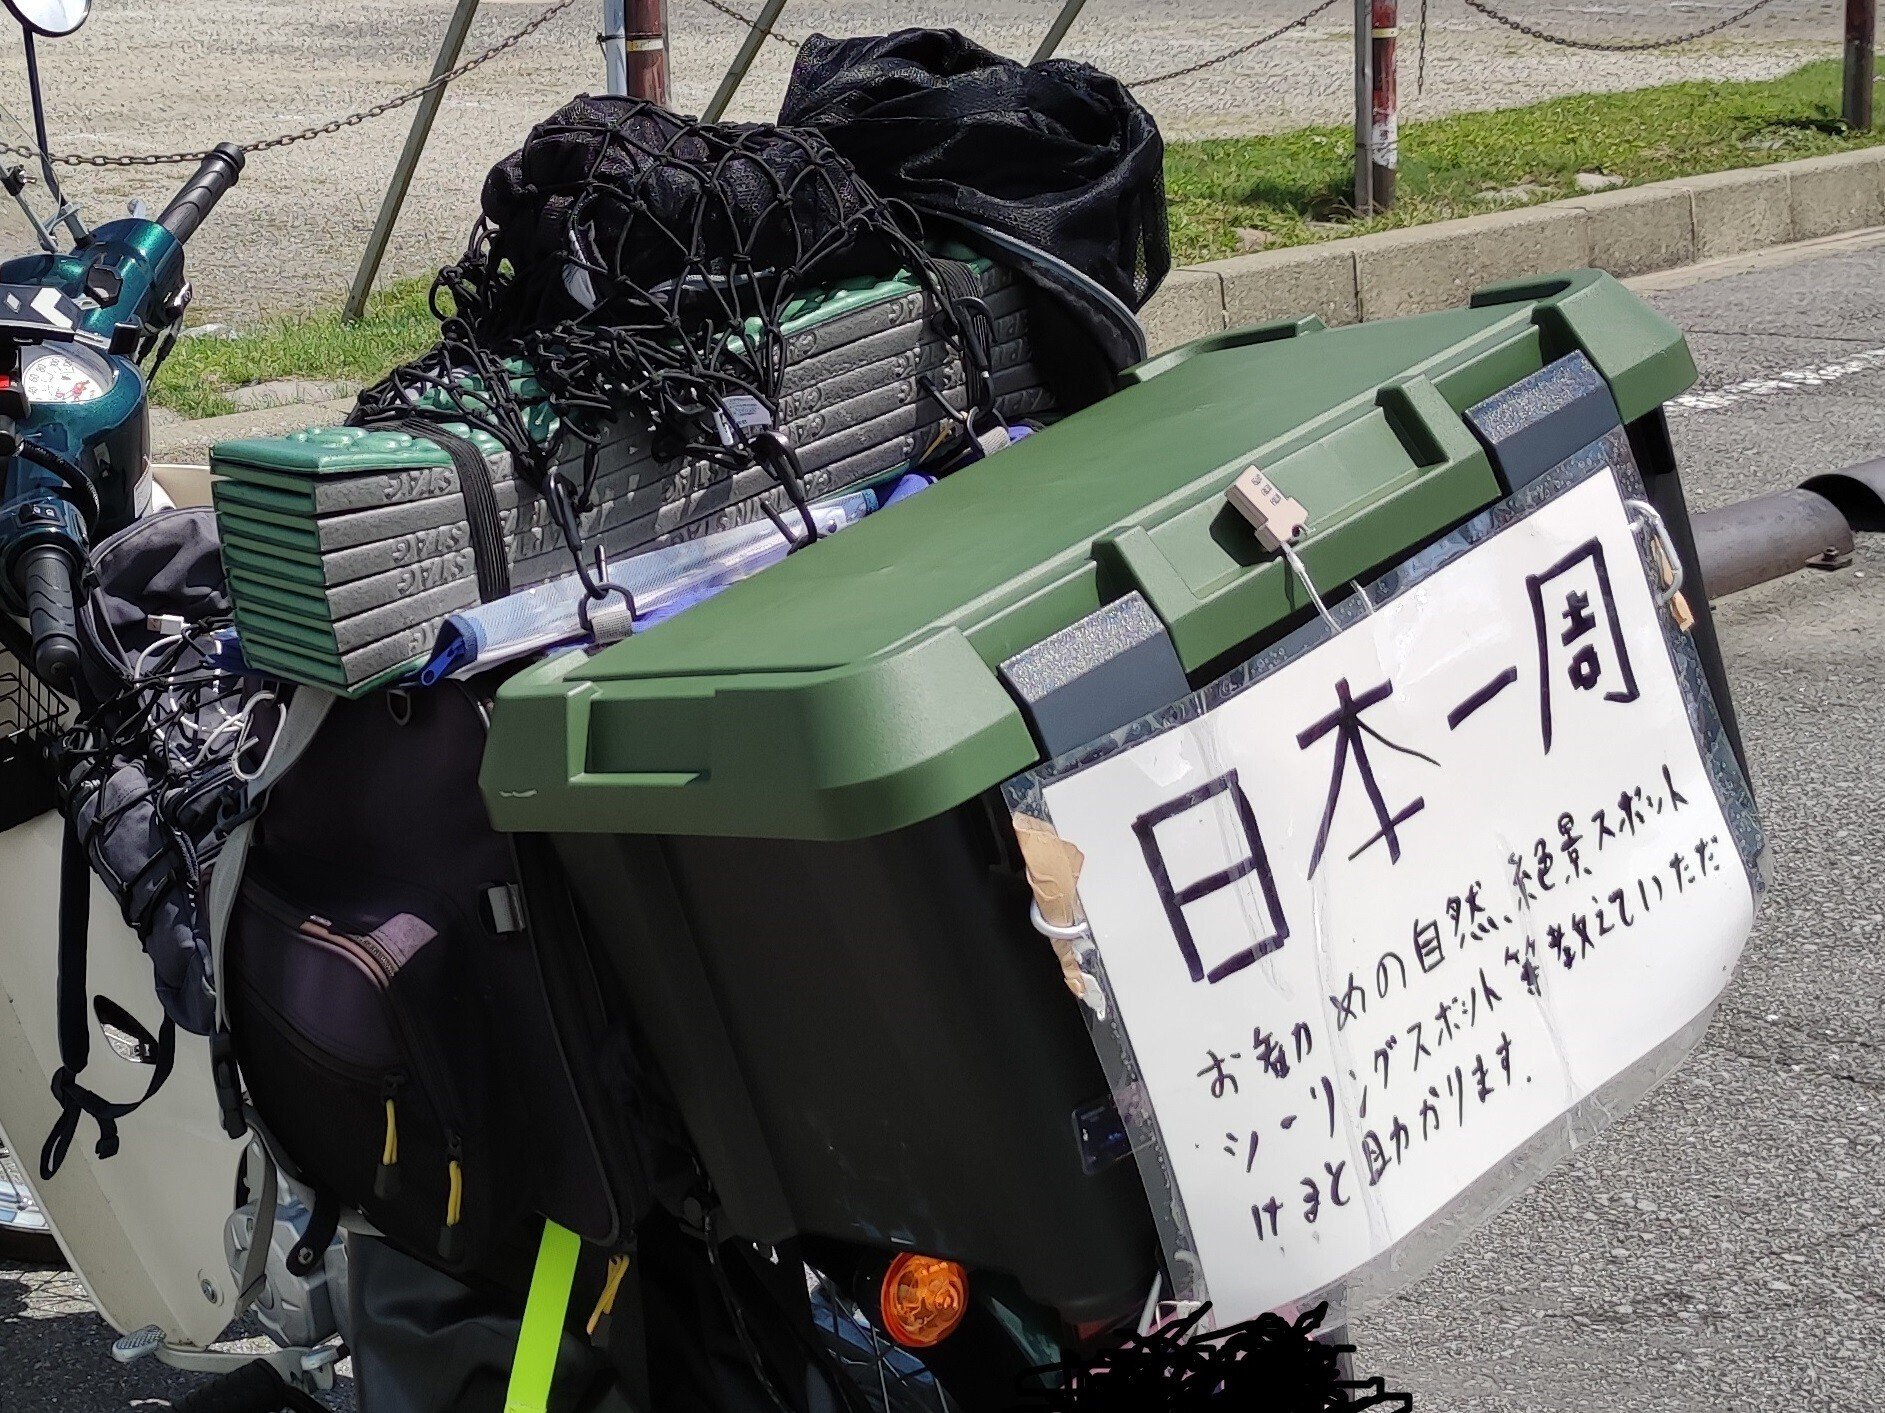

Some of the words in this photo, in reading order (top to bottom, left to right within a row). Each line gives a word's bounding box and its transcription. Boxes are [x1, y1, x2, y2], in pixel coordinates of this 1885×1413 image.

[392, 524, 463, 565] STAG
[397, 553, 467, 595] STAG
[1130, 535, 1640, 985] 日本一周
